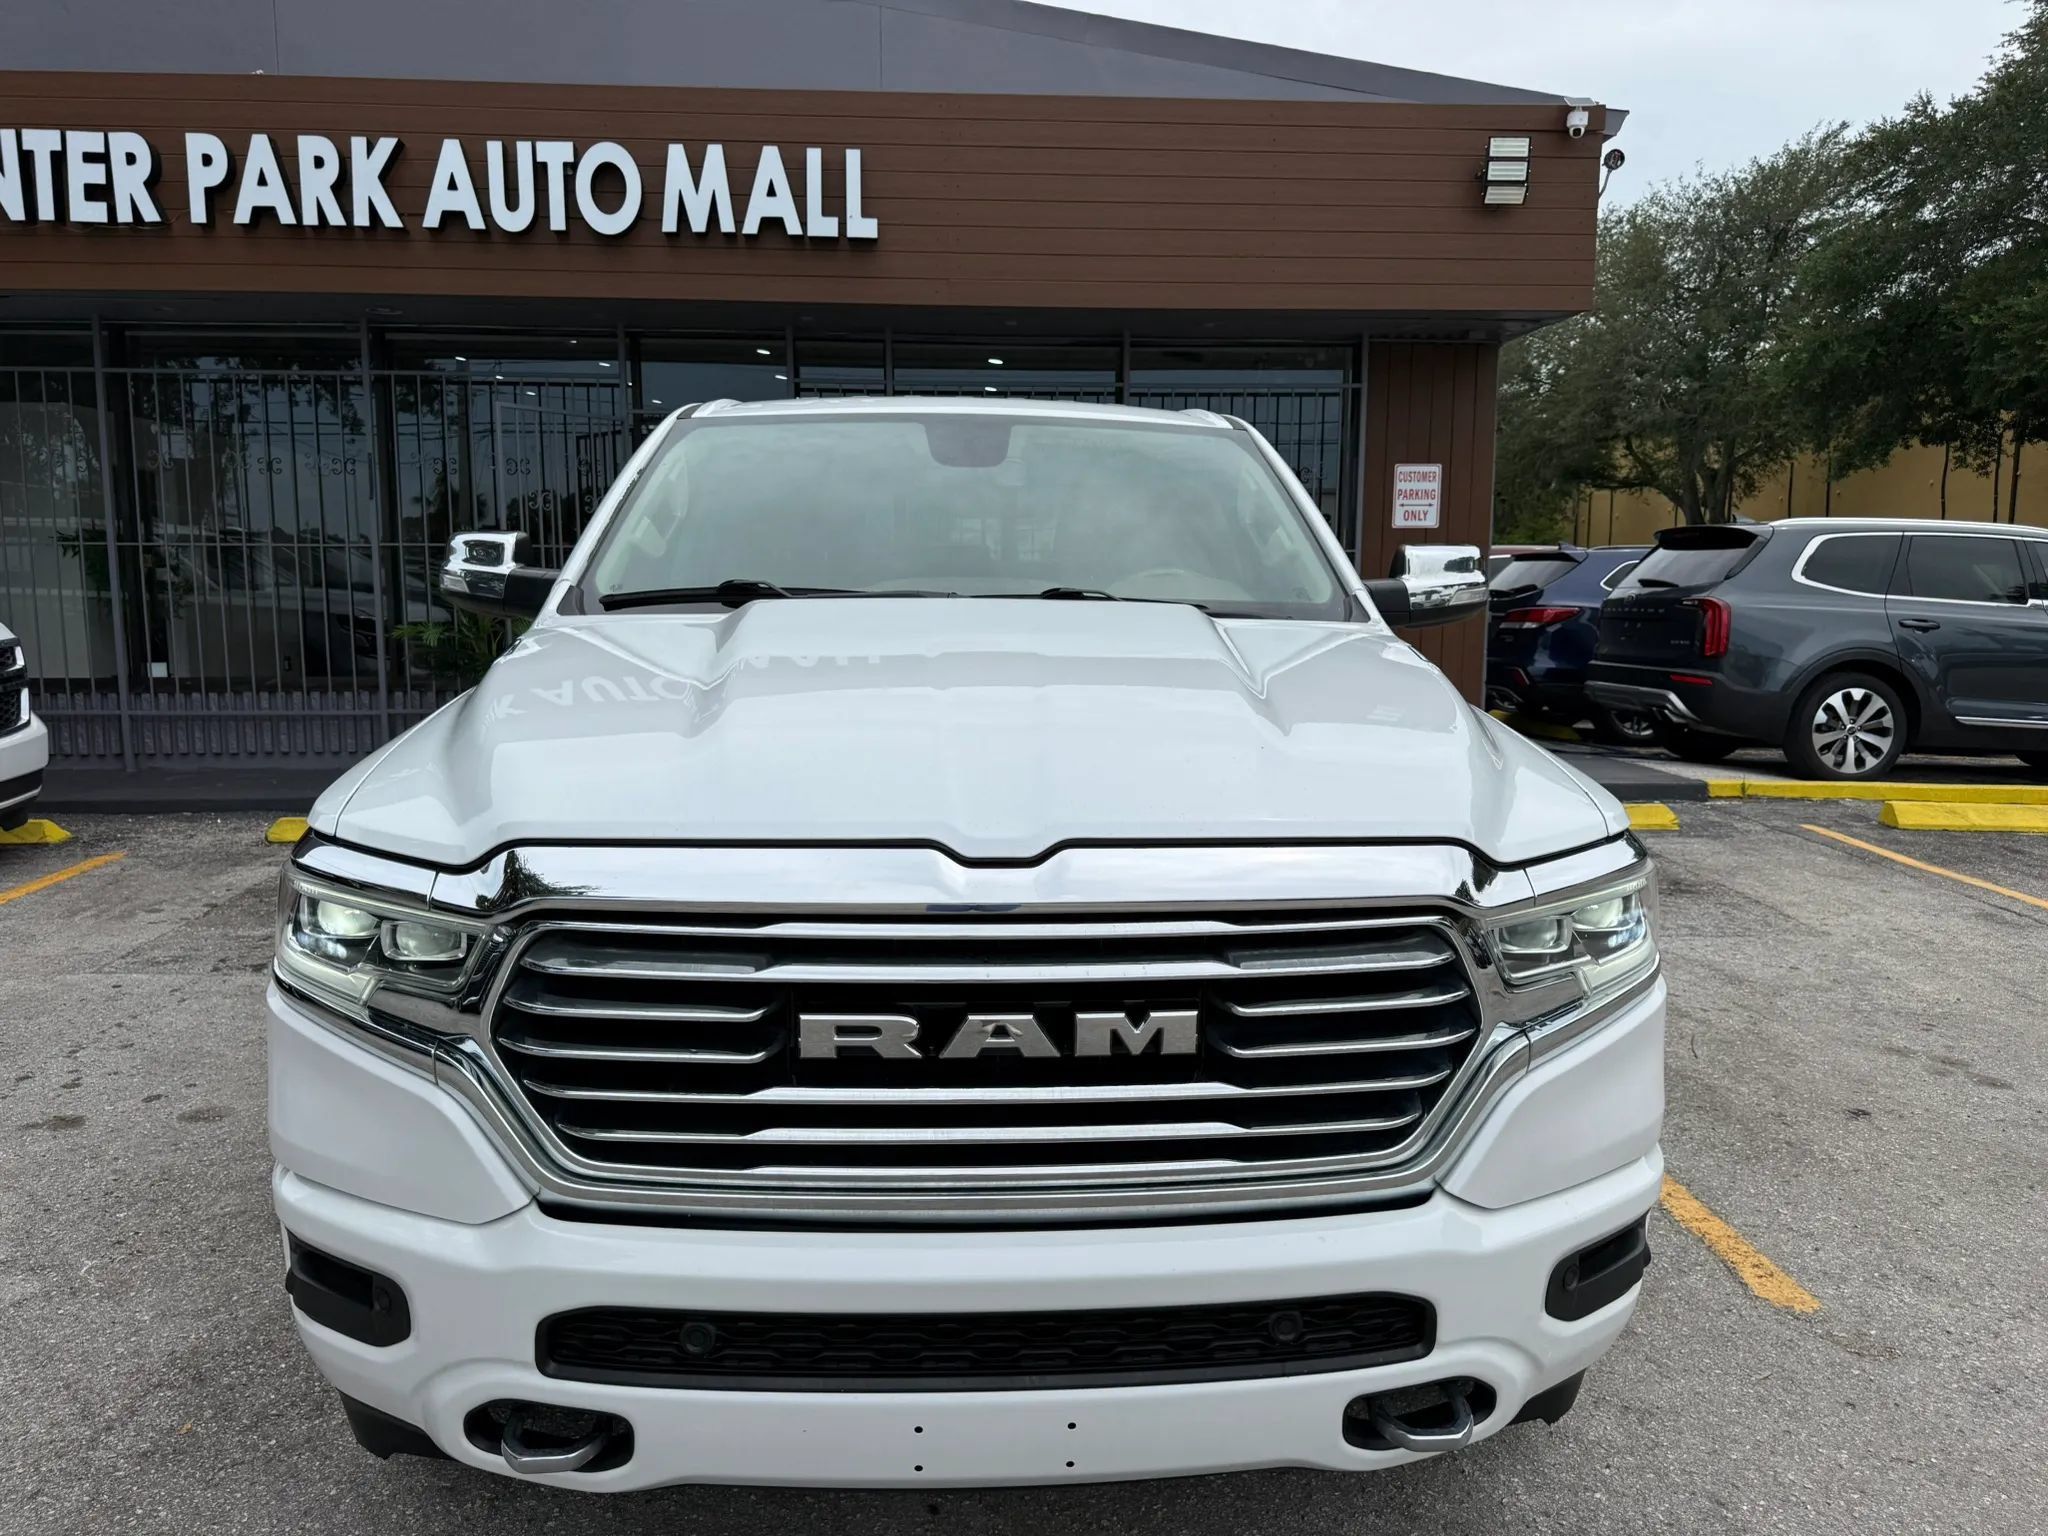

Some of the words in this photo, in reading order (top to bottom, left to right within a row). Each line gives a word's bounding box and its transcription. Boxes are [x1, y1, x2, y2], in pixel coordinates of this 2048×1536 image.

[184, 132, 404, 228] PARK
[422, 138, 642, 235] AUTO
[661, 143, 879, 239] MALL
[1397, 470, 1437, 483] CUSTOMER
[1397, 488, 1437, 501] PARKING
[1403, 509, 1430, 522] ONLY
[798, 1011, 1199, 1059] RAM
